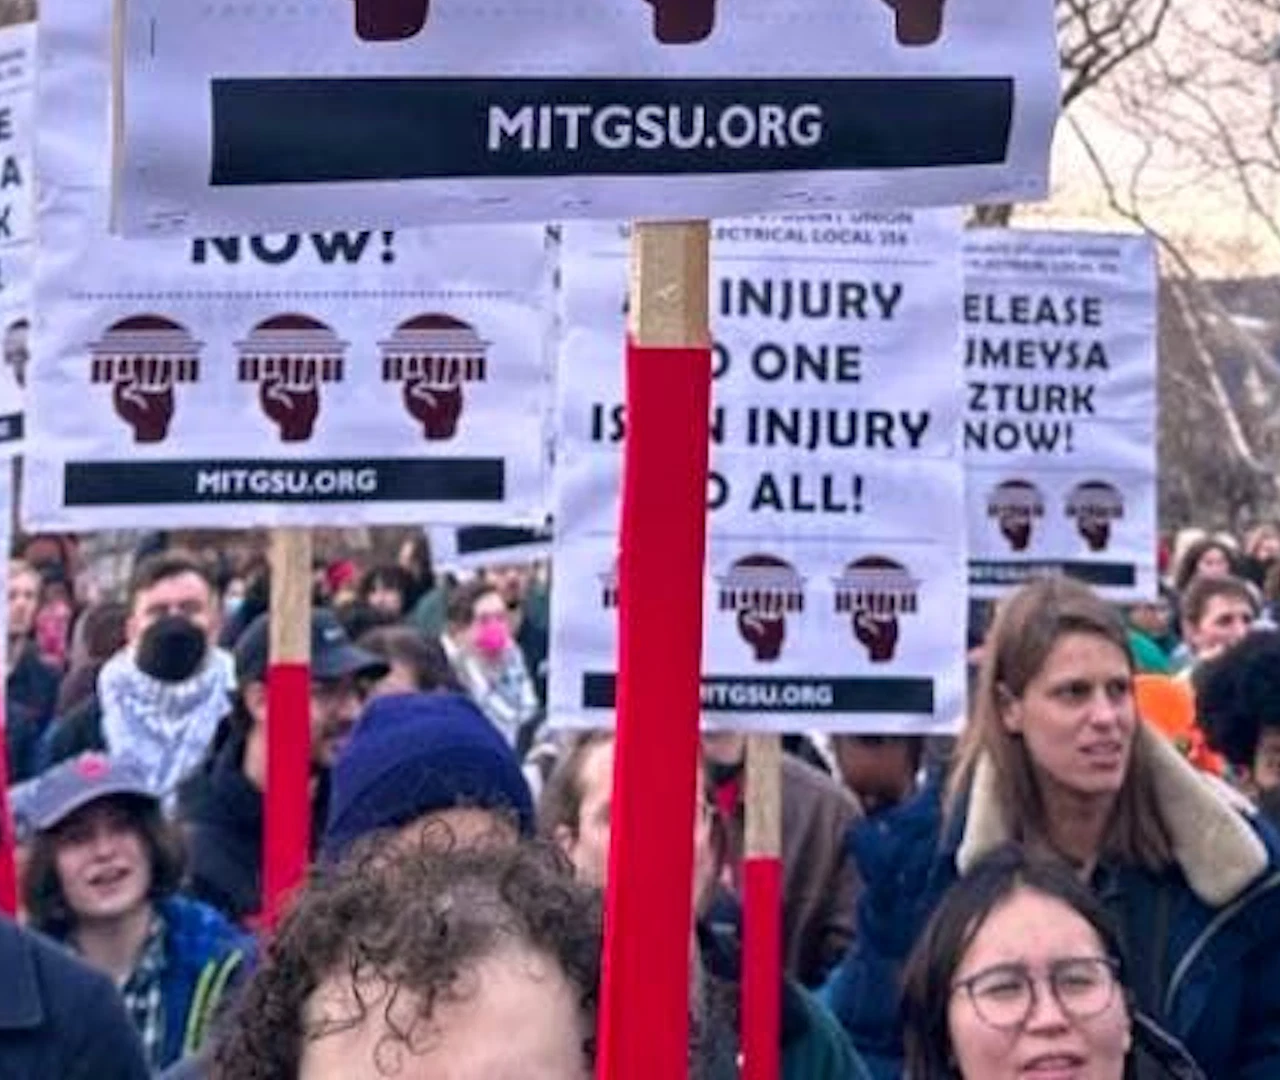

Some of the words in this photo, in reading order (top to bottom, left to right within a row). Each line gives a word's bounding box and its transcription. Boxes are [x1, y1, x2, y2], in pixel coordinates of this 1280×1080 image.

[487, 105, 823, 151] MITGSU.ORG
[812, 228, 874, 244] LOCAL
[722, 278, 904, 320] INJURY
[964, 294, 1102, 326] ELEASE
[751, 345, 862, 383] ONE
[965, 339, 1109, 370] MEYSA
[969, 383, 1094, 413] ZTURK
[747, 410, 931, 453] INJURY
[964, 421, 1073, 453] NOW!
[197, 470, 377, 495] MITGSU.ORG
[751, 474, 864, 514] ALL!
[702, 684, 833, 706] ITGSU.ORG
